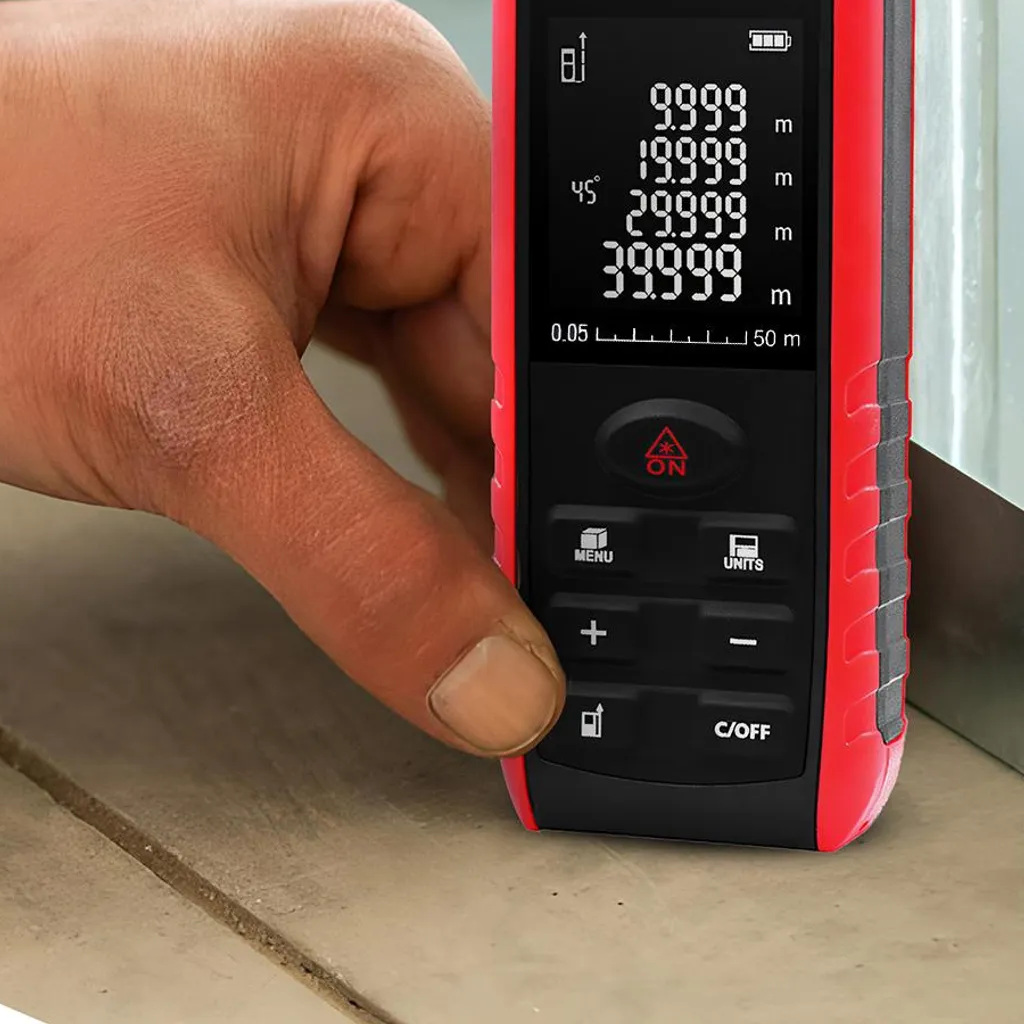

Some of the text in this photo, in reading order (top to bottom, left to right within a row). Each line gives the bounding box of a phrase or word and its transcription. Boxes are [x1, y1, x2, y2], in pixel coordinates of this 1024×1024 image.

[775, 118, 793, 133] m
[775, 171, 793, 186] m
[775, 226, 793, 241] m
[771, 287, 792, 306] m
[551, 323, 589, 342] 0.05
[753, 329, 801, 348] 50 m
[646, 459, 686, 476] ON
[574, 549, 613, 563] MENU
[724, 557, 764, 572] UNITS
[714, 721, 771, 741] C/OFF
